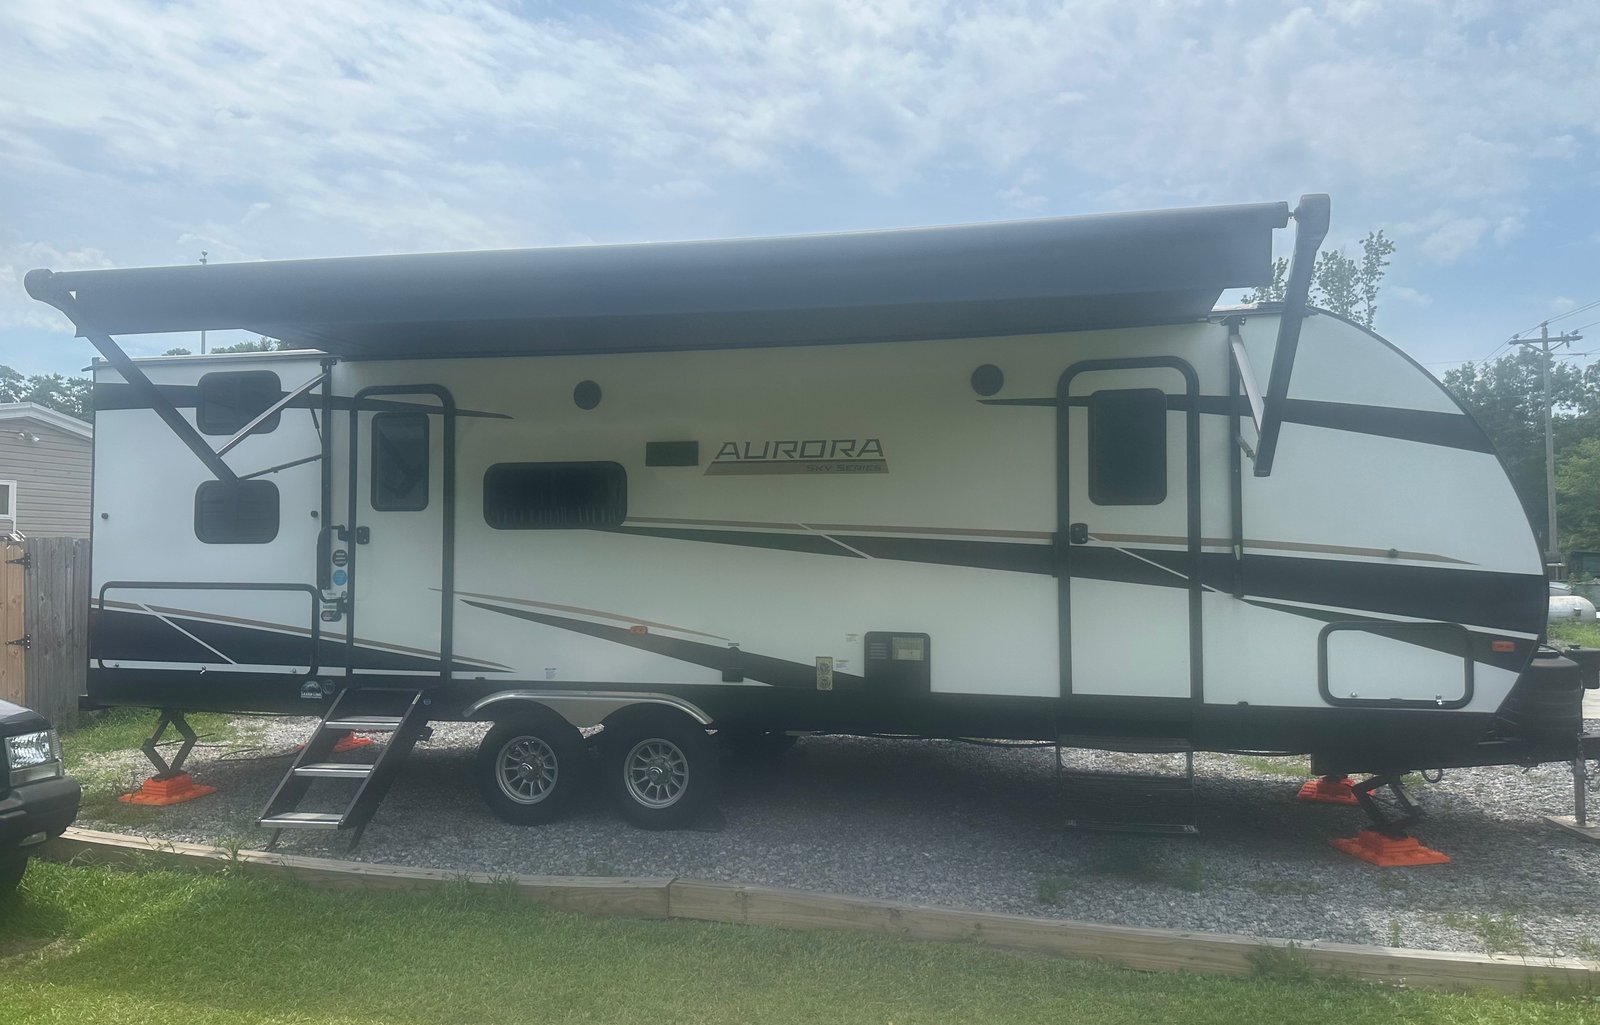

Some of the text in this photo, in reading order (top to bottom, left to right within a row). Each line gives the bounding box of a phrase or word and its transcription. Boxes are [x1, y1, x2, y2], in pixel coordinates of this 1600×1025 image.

[715, 439, 884, 460] AURORA
[806, 463, 882, 472] SKY SERIES
